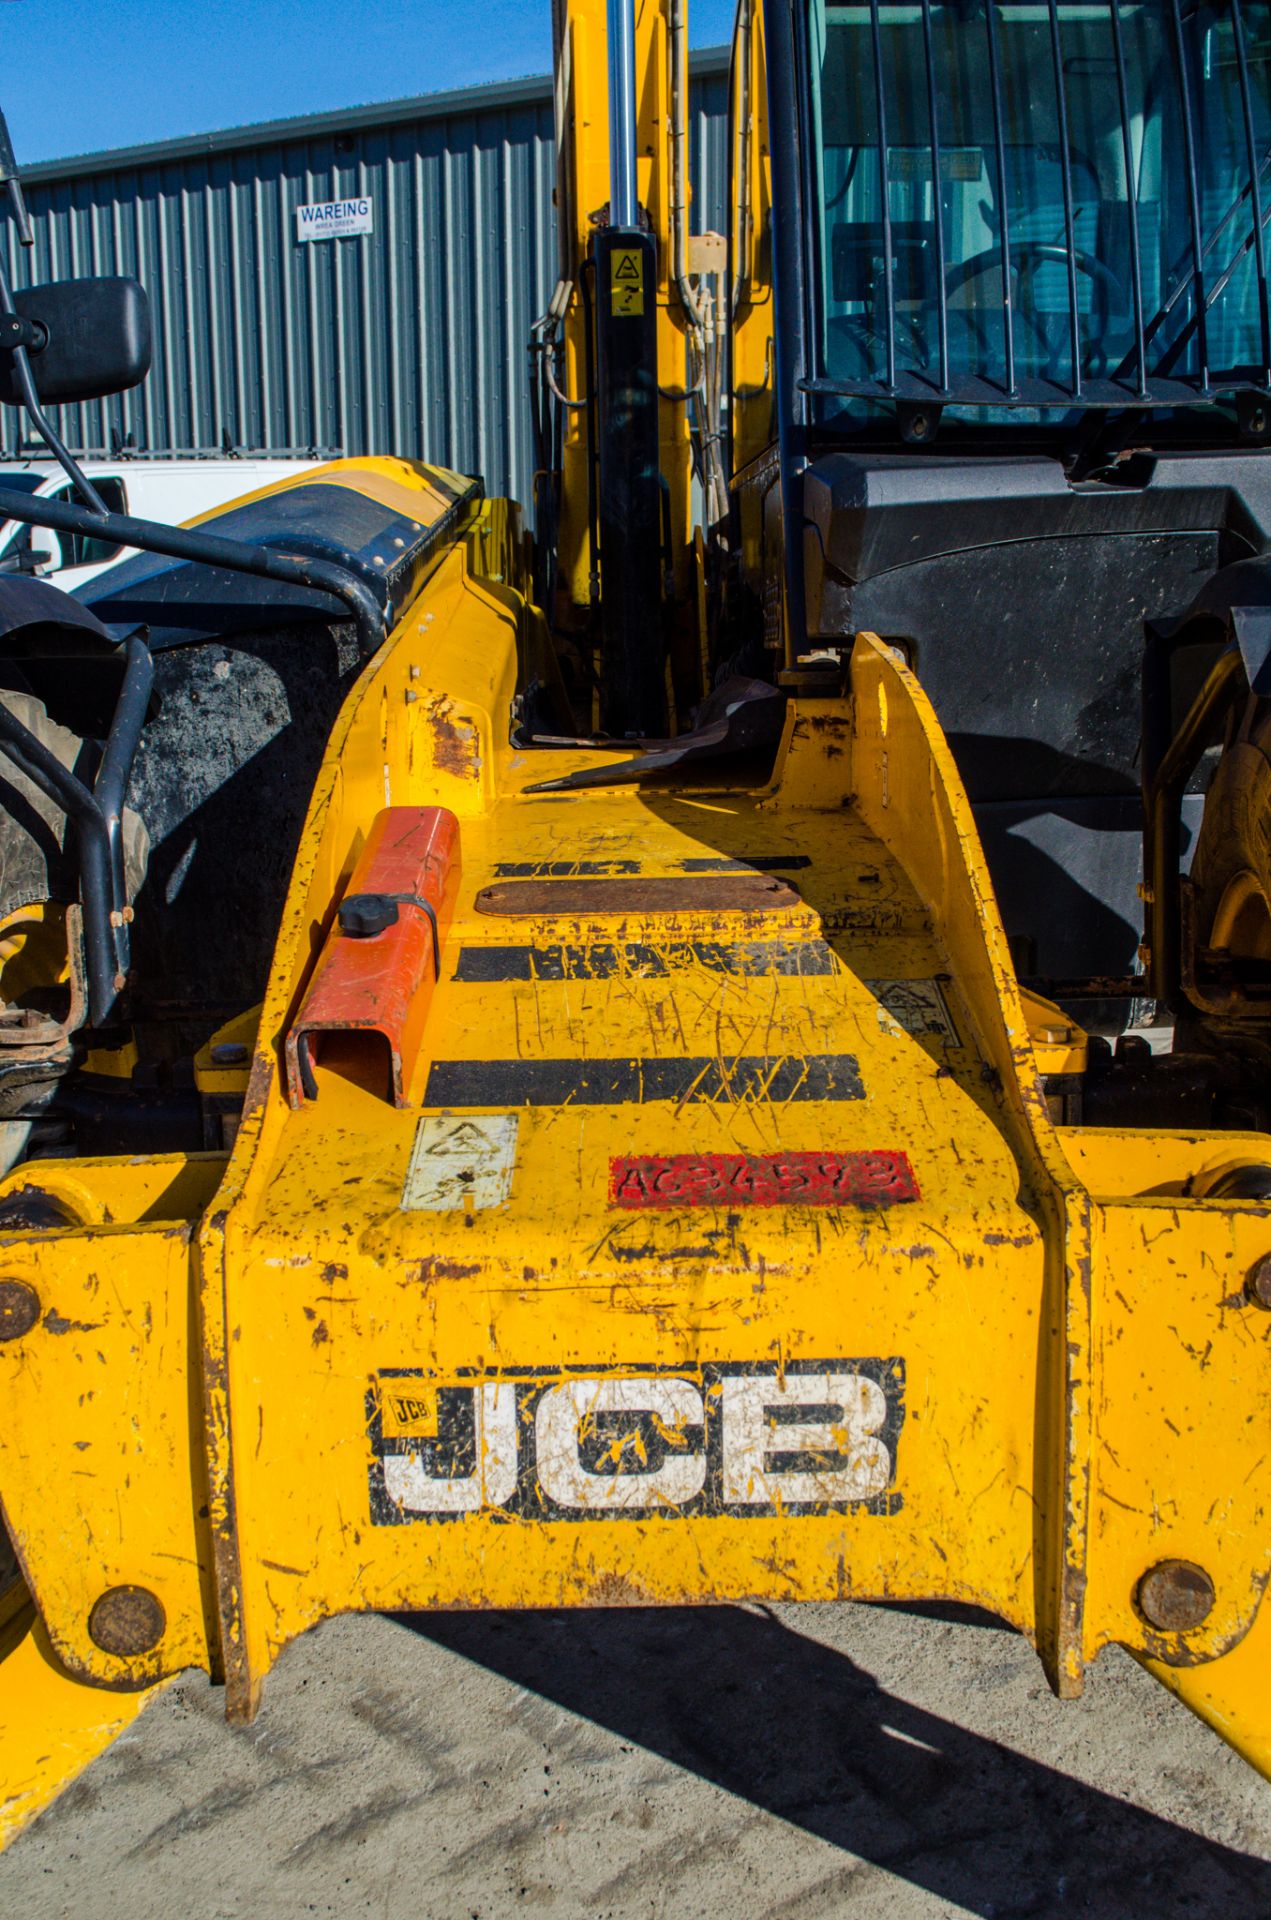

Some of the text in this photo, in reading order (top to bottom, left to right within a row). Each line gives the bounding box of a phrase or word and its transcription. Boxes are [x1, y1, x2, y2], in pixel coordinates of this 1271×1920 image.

[301, 200, 368, 223] WAREING
[395, 1398, 428, 1423] JCB
[383, 1374, 890, 1513] JCB
